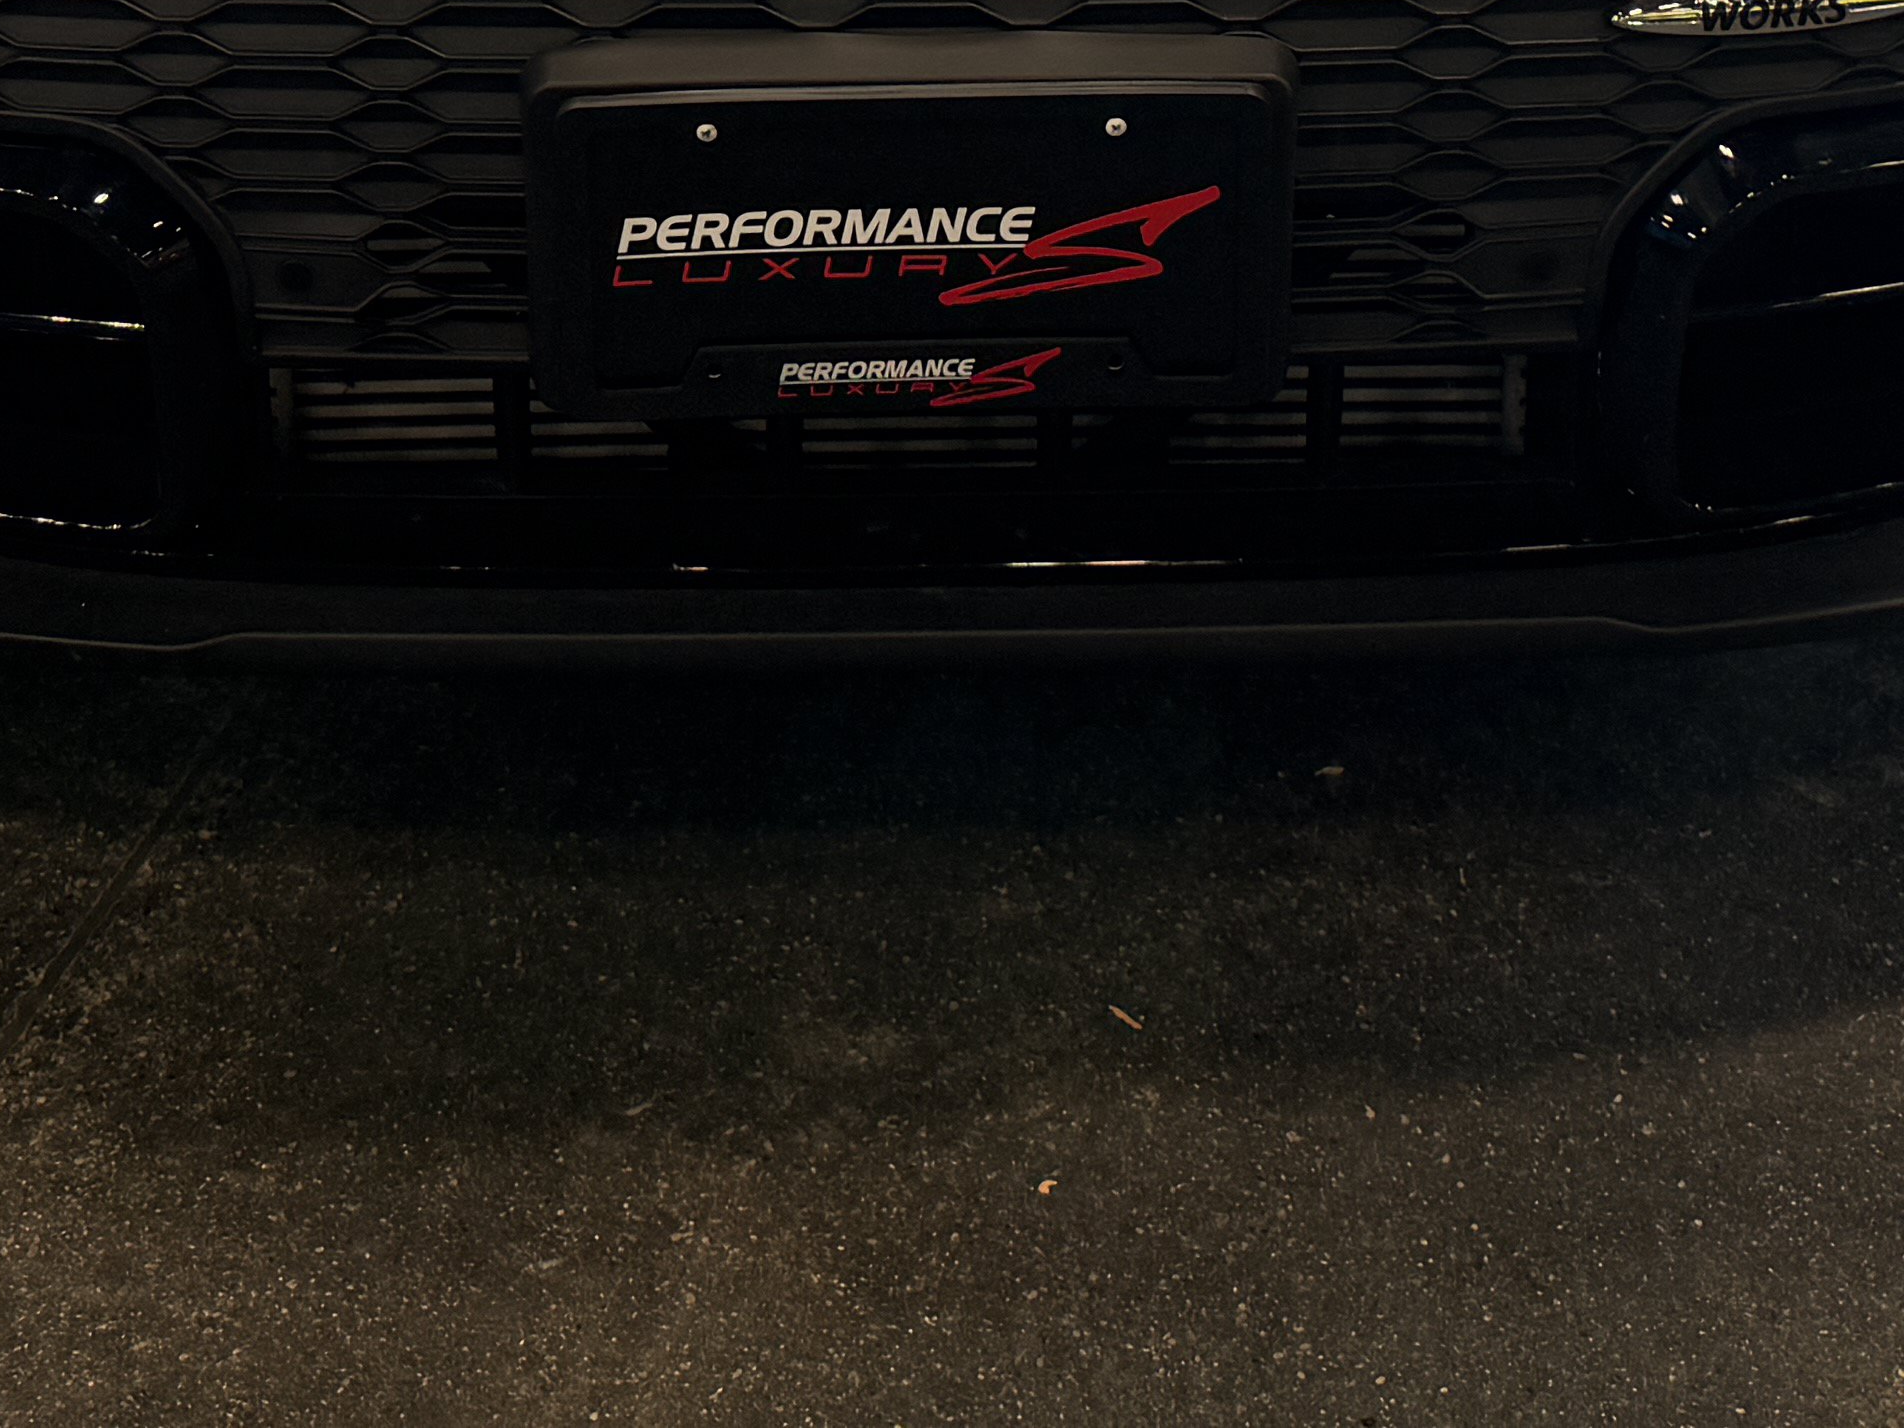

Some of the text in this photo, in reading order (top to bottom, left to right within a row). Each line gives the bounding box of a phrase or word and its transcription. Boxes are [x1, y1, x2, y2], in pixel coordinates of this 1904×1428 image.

[618, 207, 1035, 253] PERFORMANCE
[613, 254, 1017, 286] LUXURY
[781, 358, 976, 383] PERFORMANCE
[778, 382, 964, 398] LUXURY
